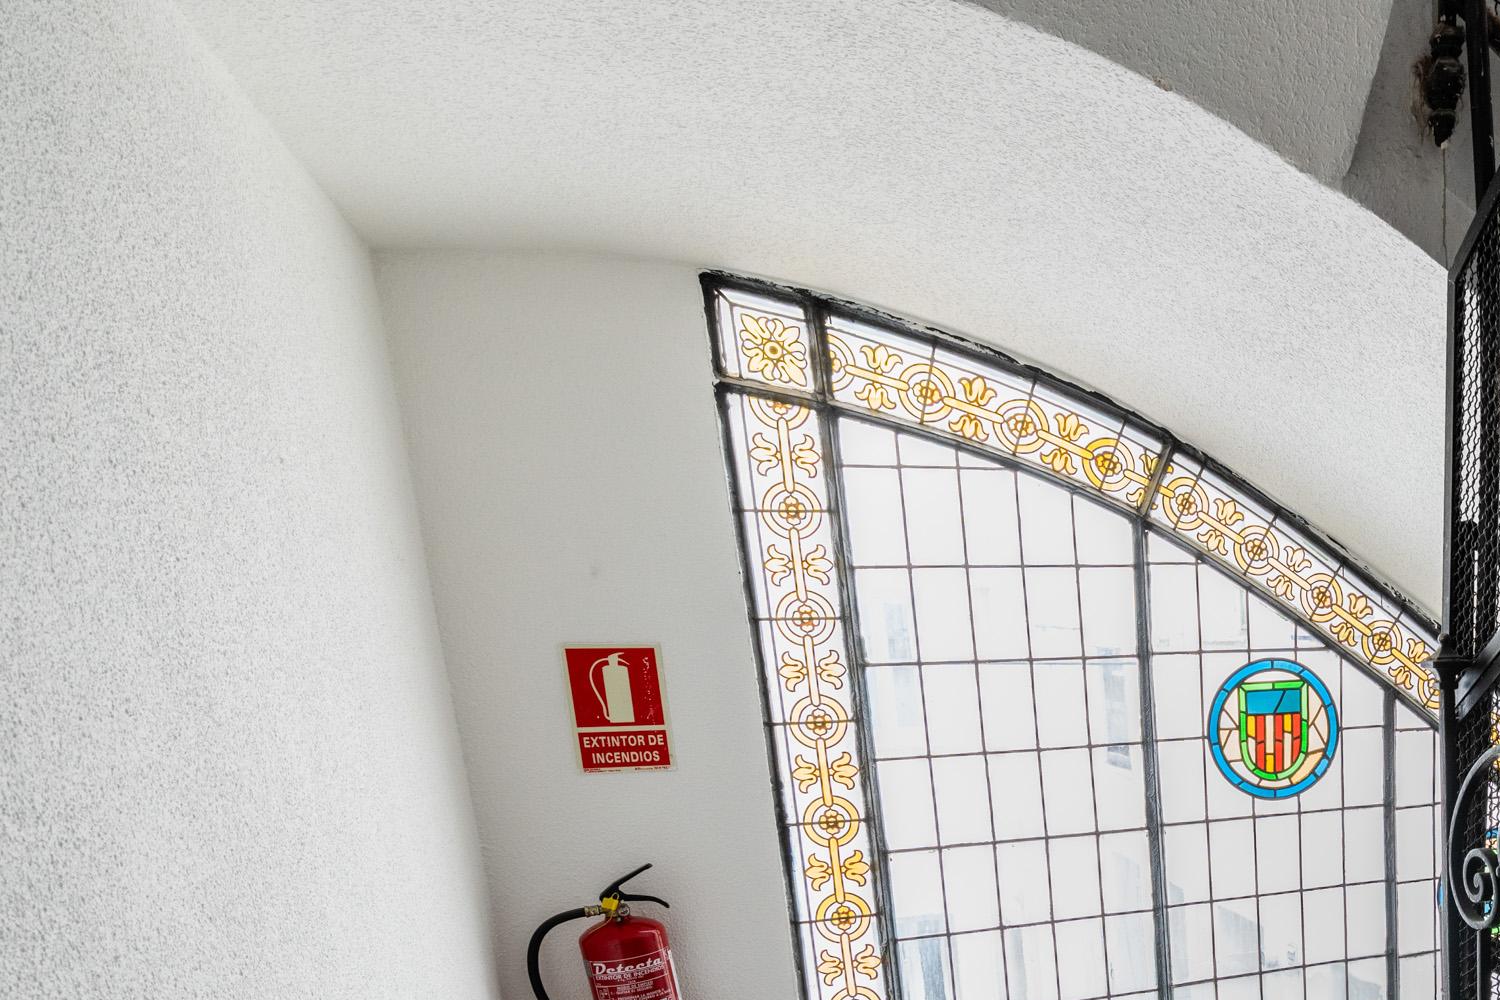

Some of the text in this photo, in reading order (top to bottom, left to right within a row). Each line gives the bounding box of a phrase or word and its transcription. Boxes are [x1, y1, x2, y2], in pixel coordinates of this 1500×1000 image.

[583, 734, 665, 748] EXTINTOR DE
[592, 750, 660, 764] INCENDIOS
[593, 957, 662, 975] Detecta
